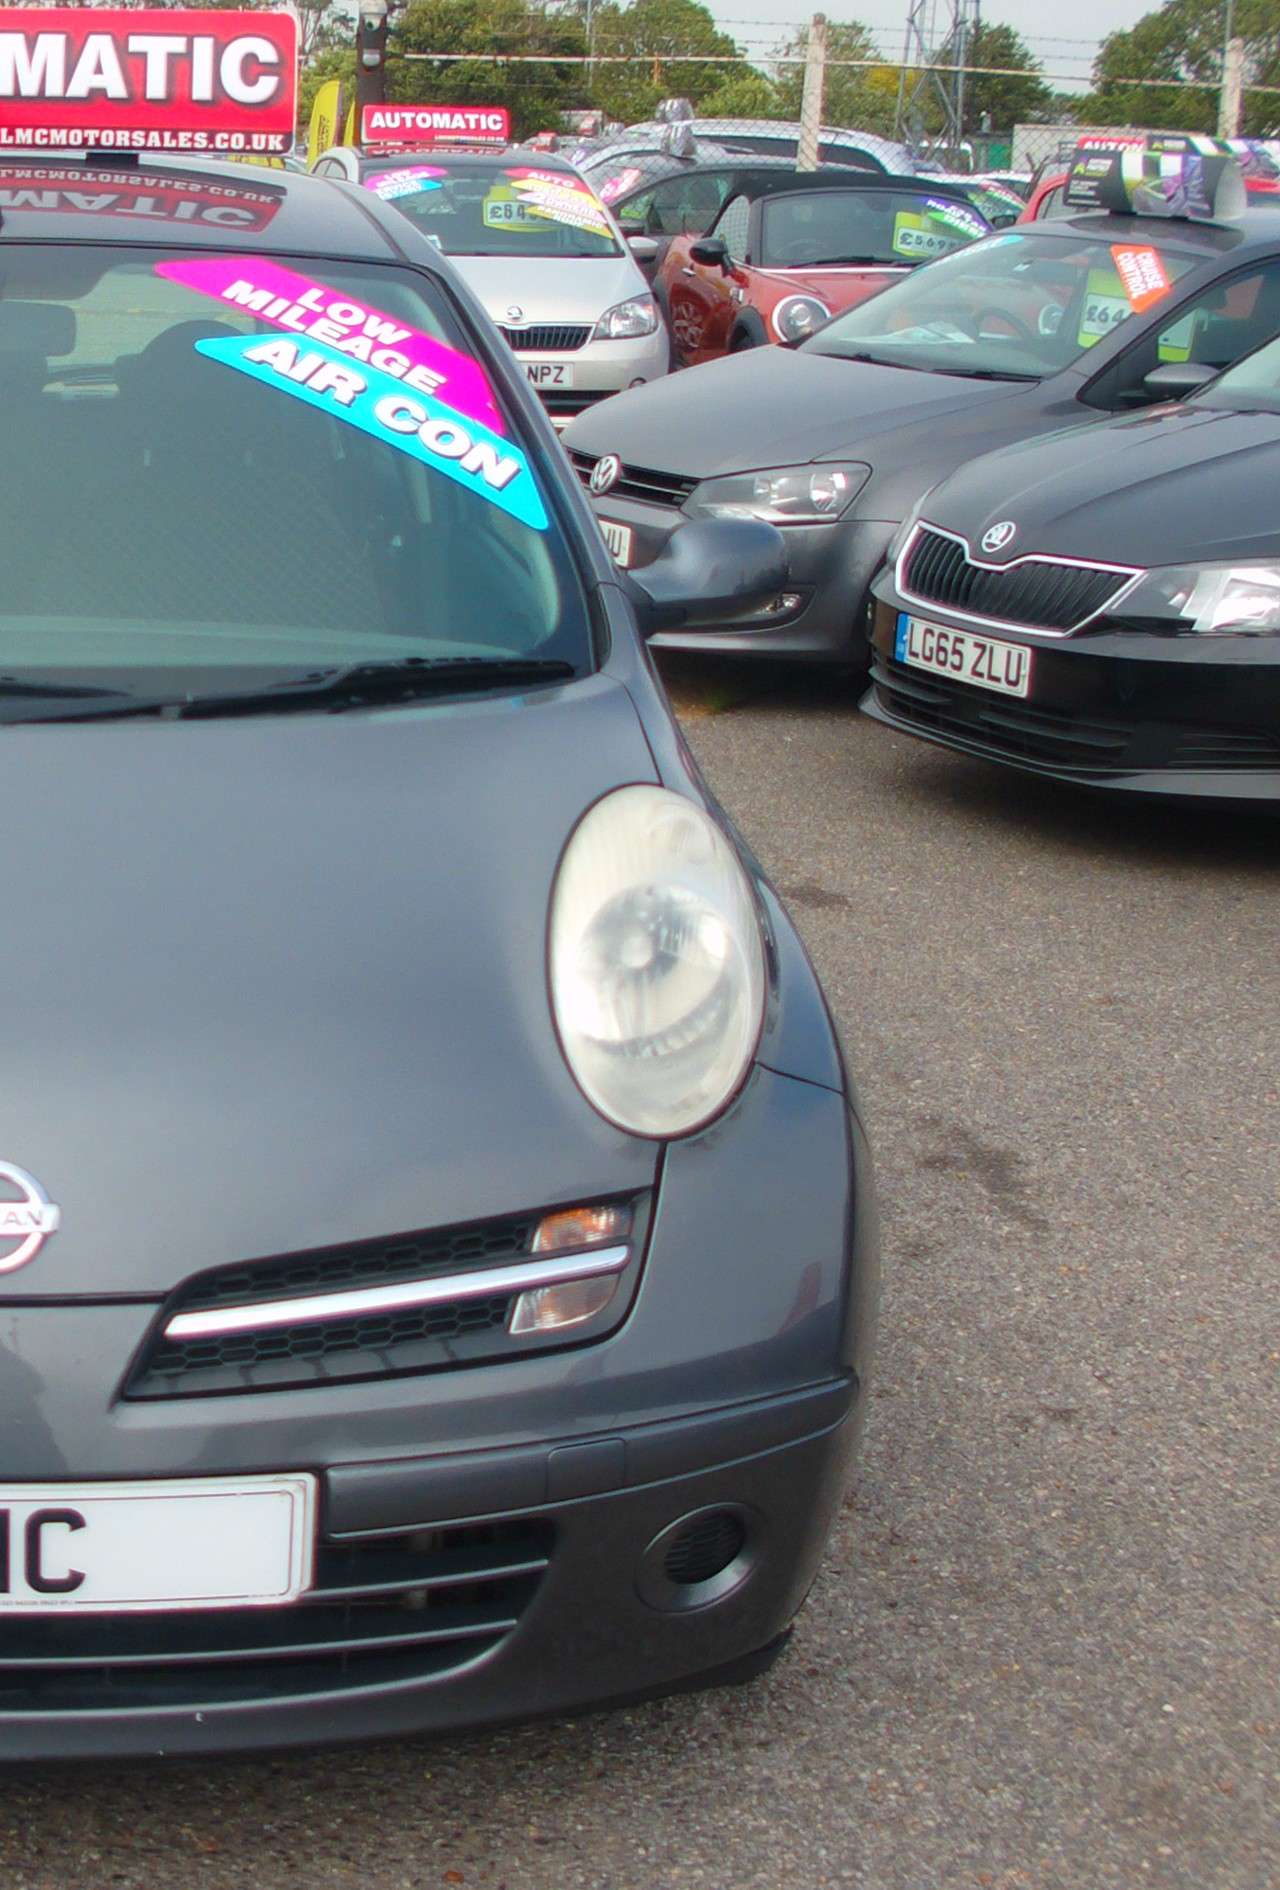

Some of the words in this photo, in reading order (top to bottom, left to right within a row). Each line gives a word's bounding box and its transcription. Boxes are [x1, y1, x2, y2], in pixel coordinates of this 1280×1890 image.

[0, 127, 285, 150] LMCMOTORSALES.CO.UK
[370, 111, 503, 131] AUTOMATIC
[527, 172, 575, 188] AUTO
[1117, 252, 1148, 299] CONTROL
[1136, 252, 1165, 289] CRUISE
[222, 280, 447, 395] MILEAGE
[296, 288, 412, 346] LOW
[527, 365, 564, 384] NPZ
[244, 340, 368, 407] AIR
[374, 394, 522, 491] CON
[908, 622, 965, 673] LG65
[970, 641, 1023, 688] ZLU
